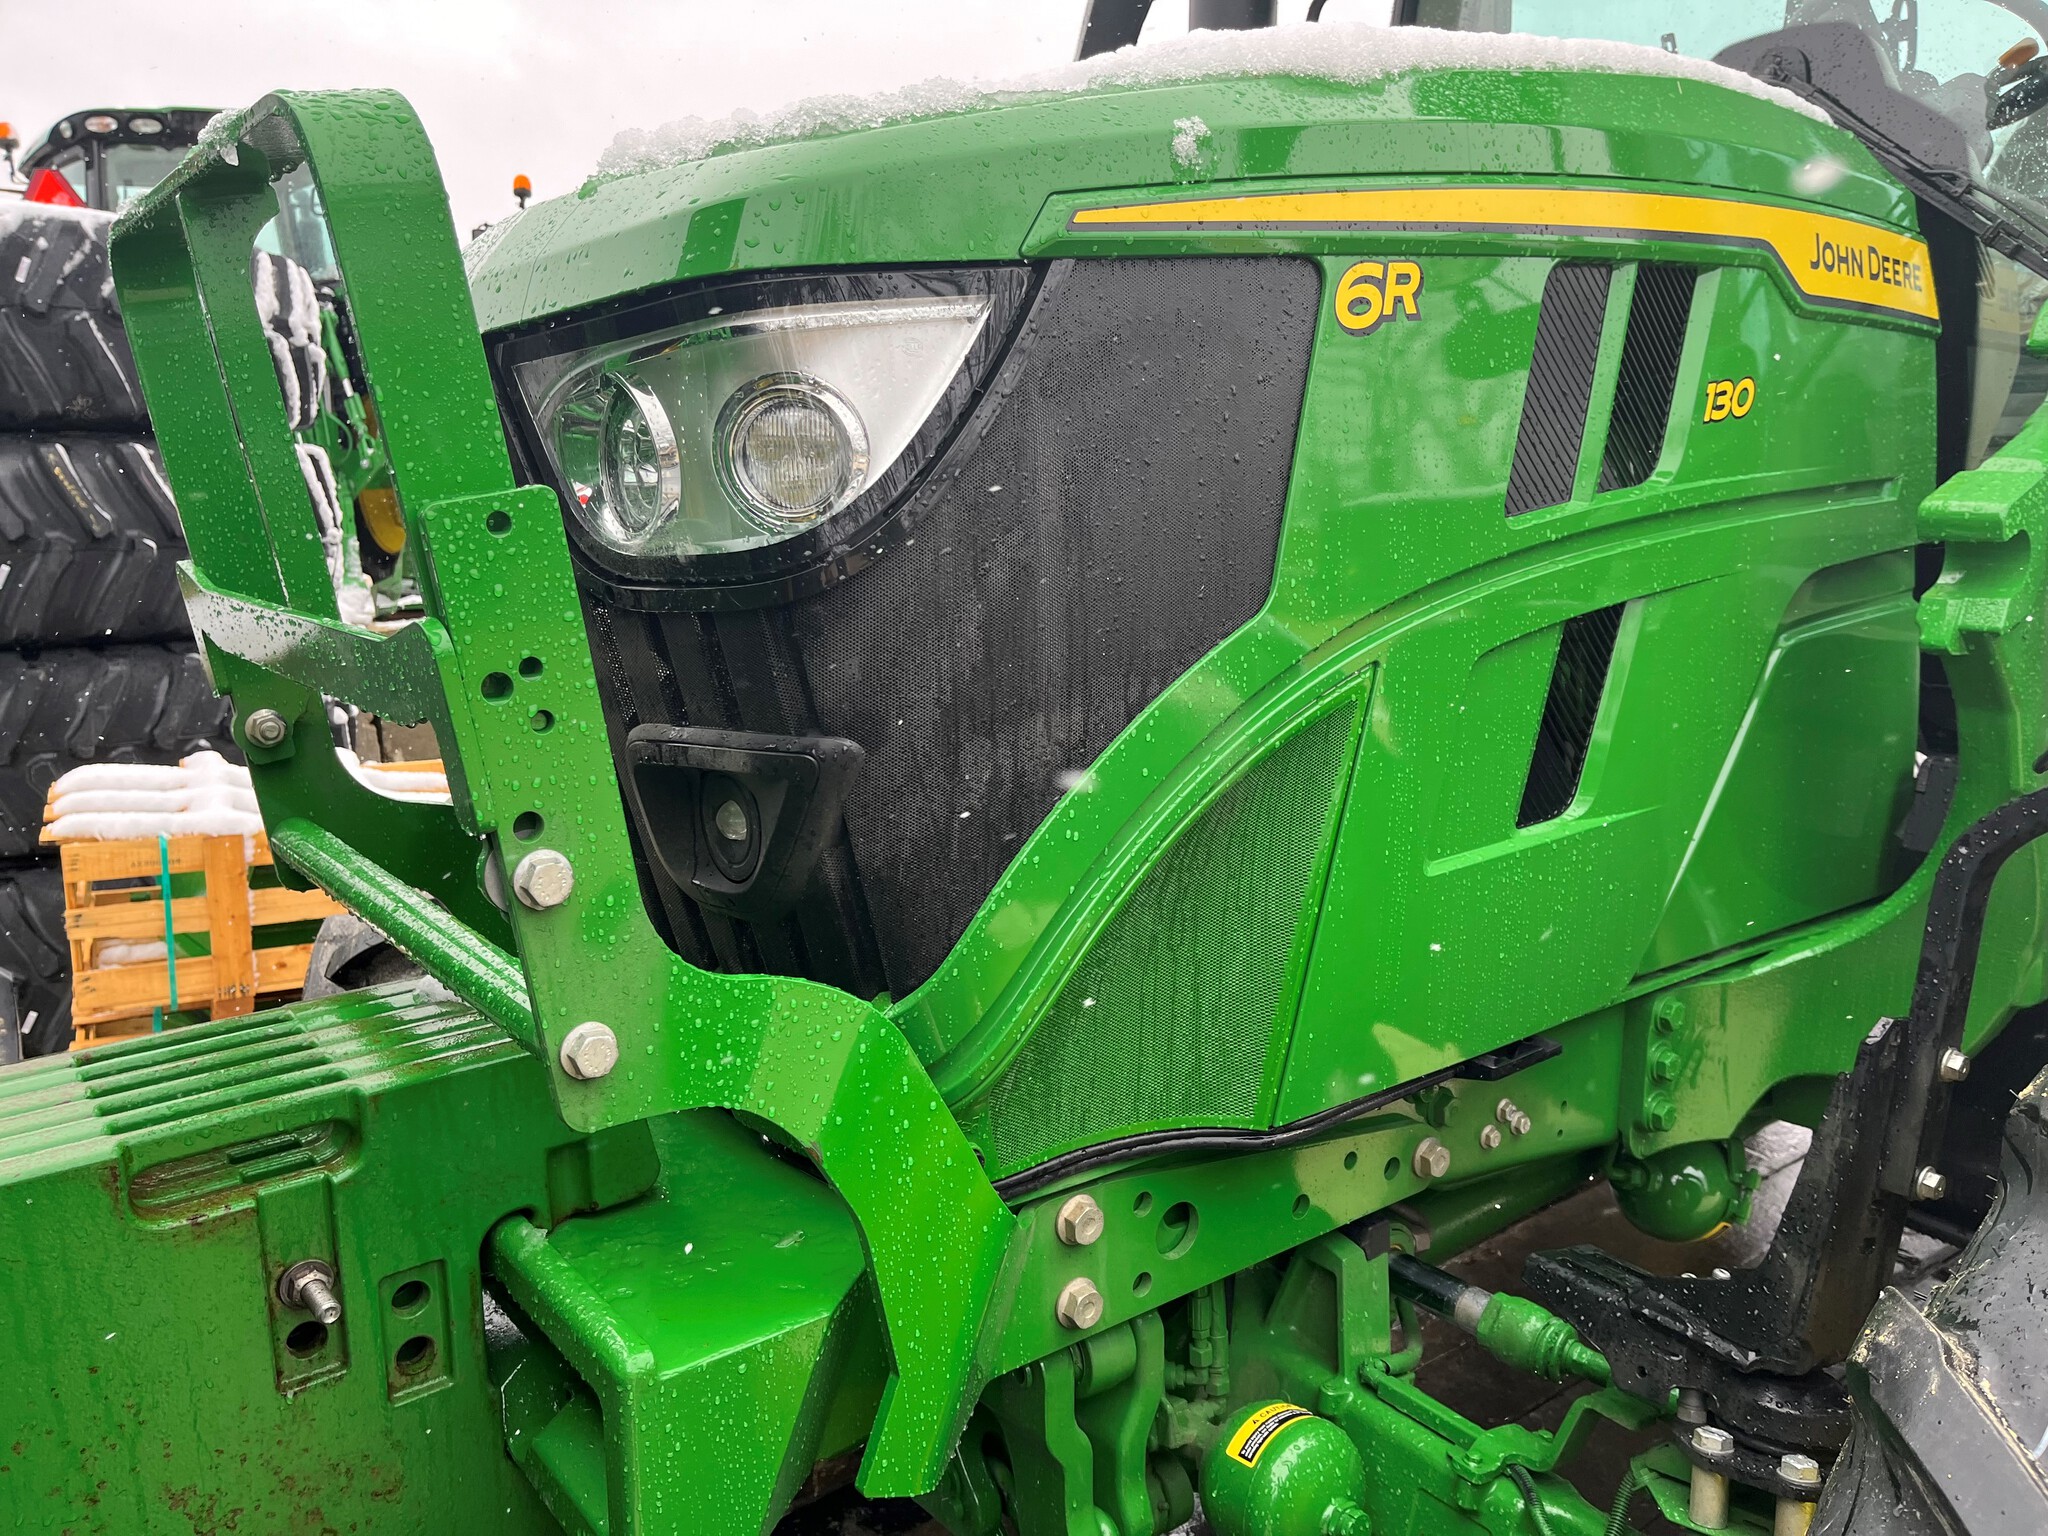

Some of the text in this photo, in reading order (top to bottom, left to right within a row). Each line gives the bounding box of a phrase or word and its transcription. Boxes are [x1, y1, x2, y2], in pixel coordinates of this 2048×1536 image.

[1810, 233, 1922, 292] JOHN DEERE
[1334, 260, 1424, 337] 6R
[1703, 376, 1756, 424] 130
